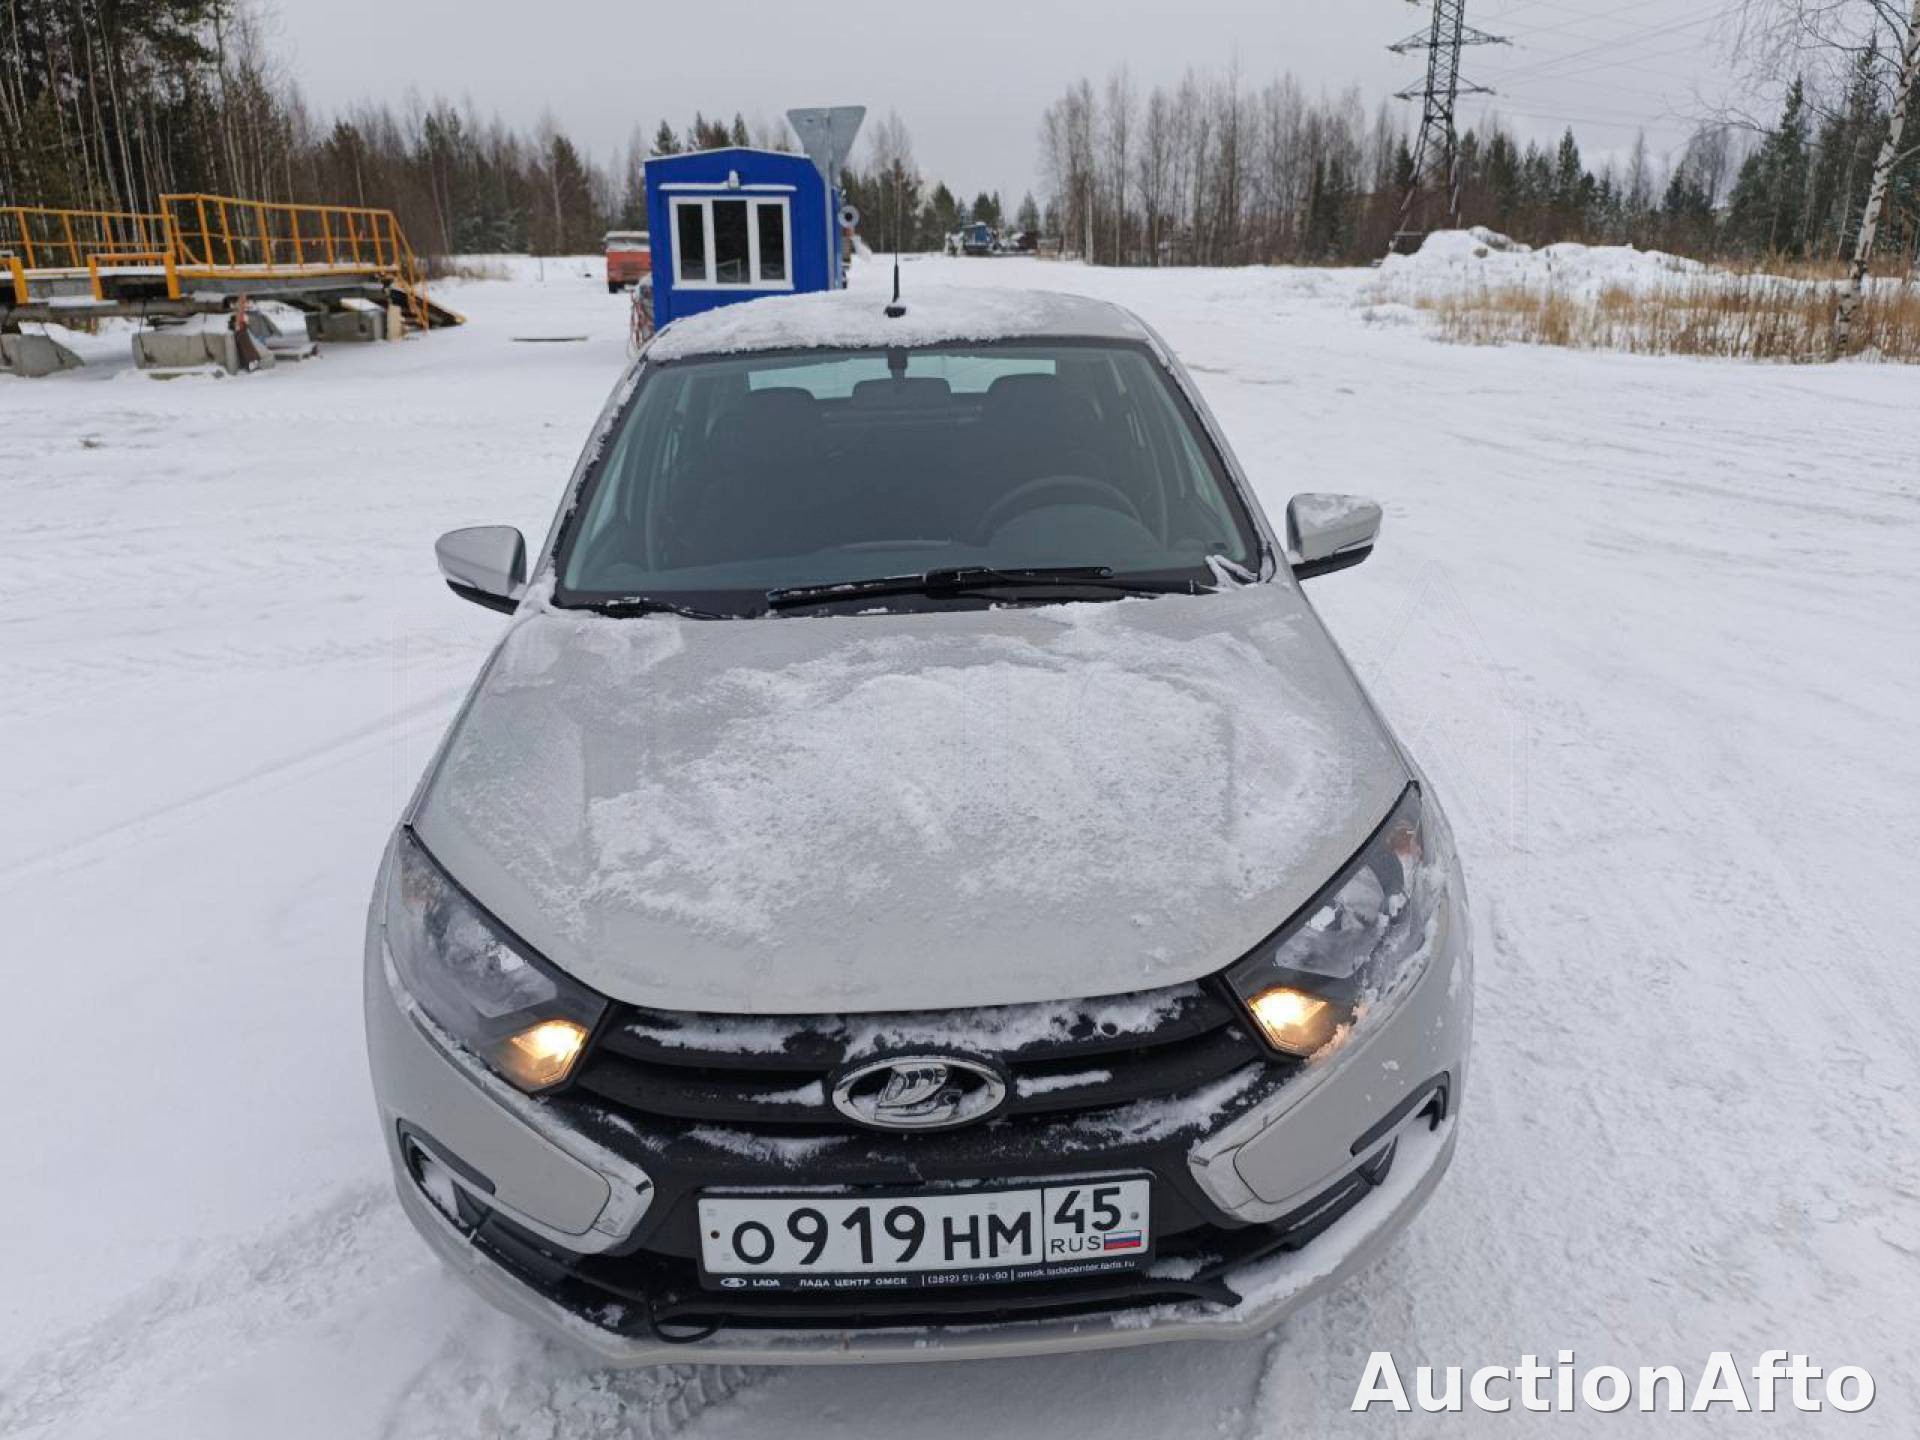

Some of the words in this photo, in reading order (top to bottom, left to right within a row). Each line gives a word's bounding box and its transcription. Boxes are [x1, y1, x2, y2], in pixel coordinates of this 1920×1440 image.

[1053, 1187, 1121, 1234] 45
[1050, 1235, 1100, 1254] RUS
[752, 1278, 780, 1287] LADA
[834, 1278, 870, 1288] ЦЕНТР
